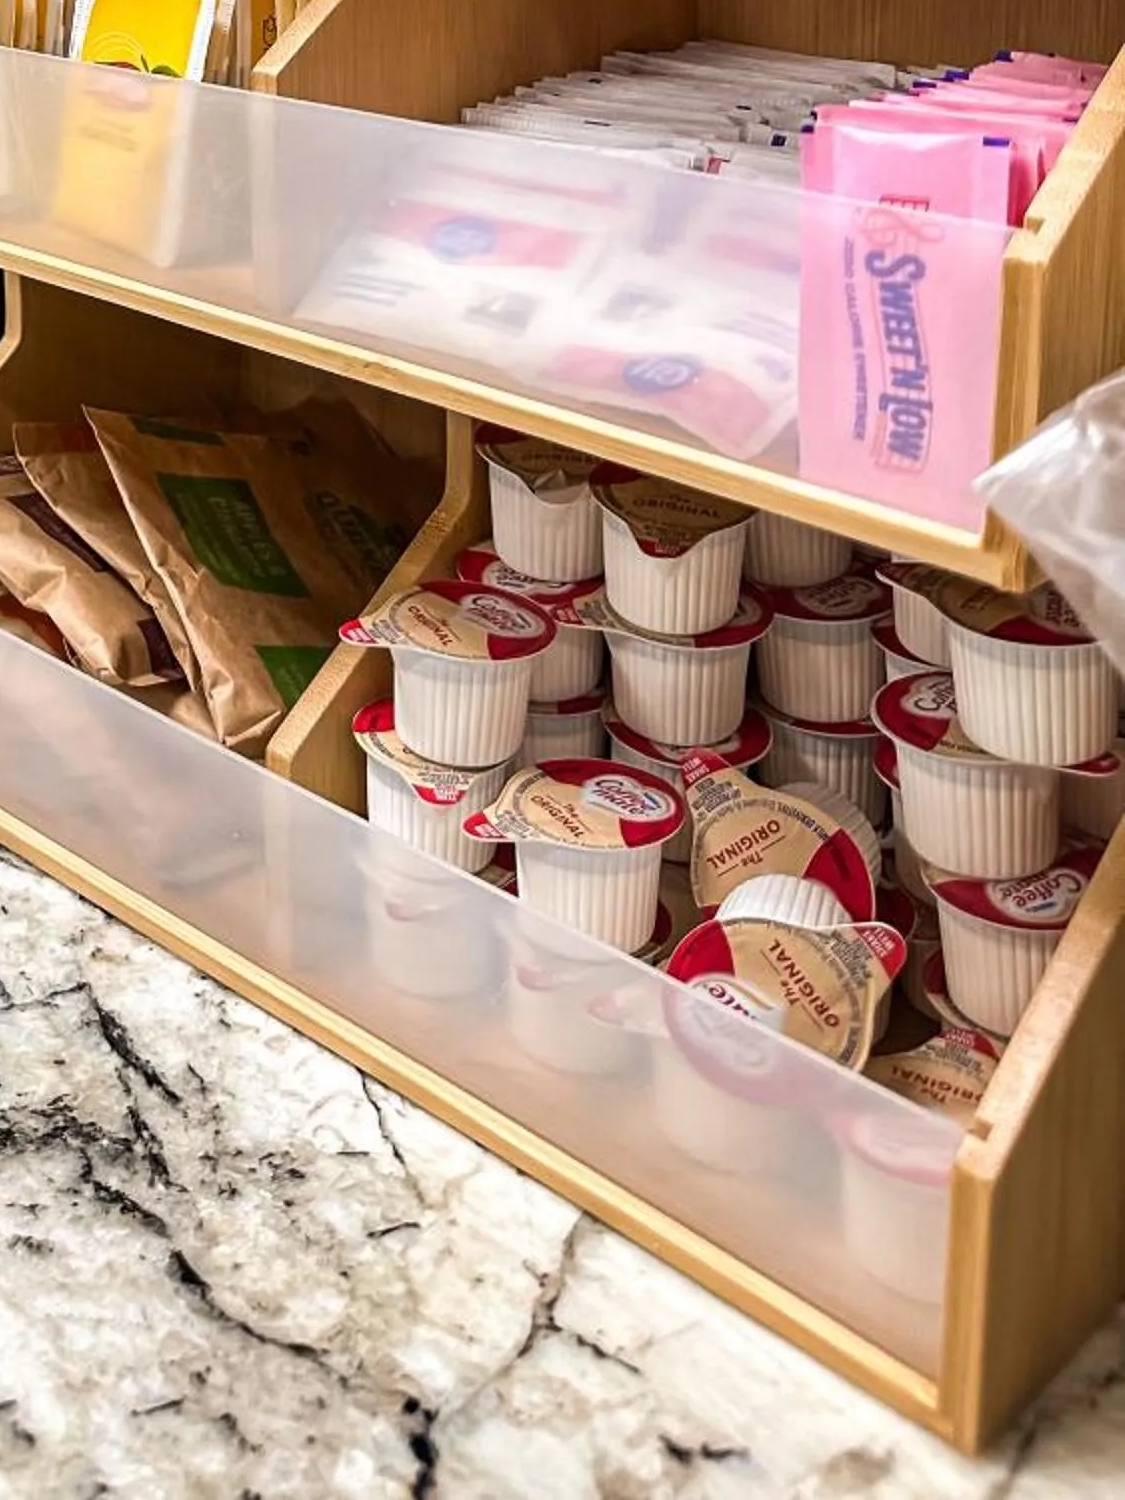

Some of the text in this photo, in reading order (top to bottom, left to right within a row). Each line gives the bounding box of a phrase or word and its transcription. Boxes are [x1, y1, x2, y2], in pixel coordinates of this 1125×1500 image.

[530, 795, 586, 838] ORIGINAL
[706, 819, 781, 869] ORIGINAL
[741, 849, 764, 867] The
[1011, 873, 1082, 908] Coffee
[768, 938, 840, 1028] ORIGINAL
[780, 980, 800, 1007] The
